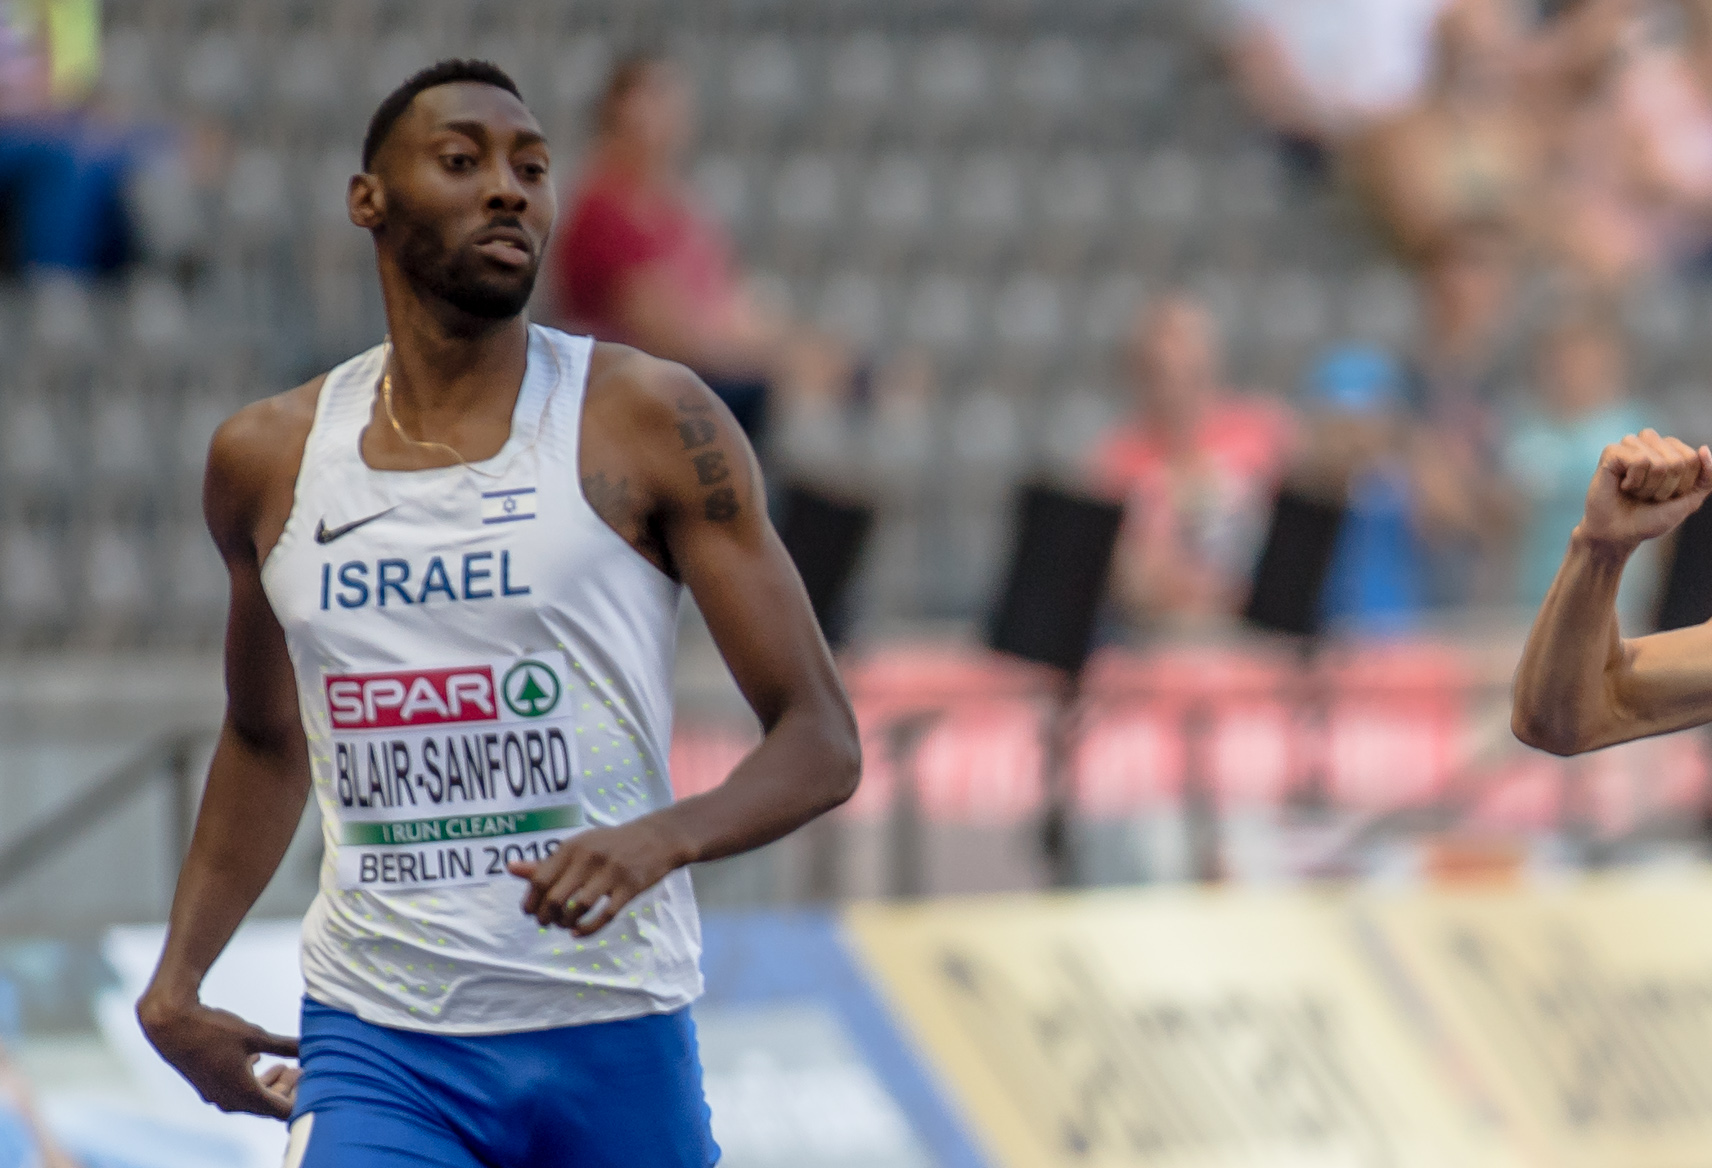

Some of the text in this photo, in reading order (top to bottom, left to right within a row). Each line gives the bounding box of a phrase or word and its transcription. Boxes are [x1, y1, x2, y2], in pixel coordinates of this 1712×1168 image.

[320, 550, 531, 611] ISRAEL
[329, 674, 494, 722] SPAR
[335, 727, 571, 809] BLAIR-SANFORD
[382, 824, 390, 842] I
[392, 821, 440, 841] RUN
[359, 848, 473, 884] BERLIN
